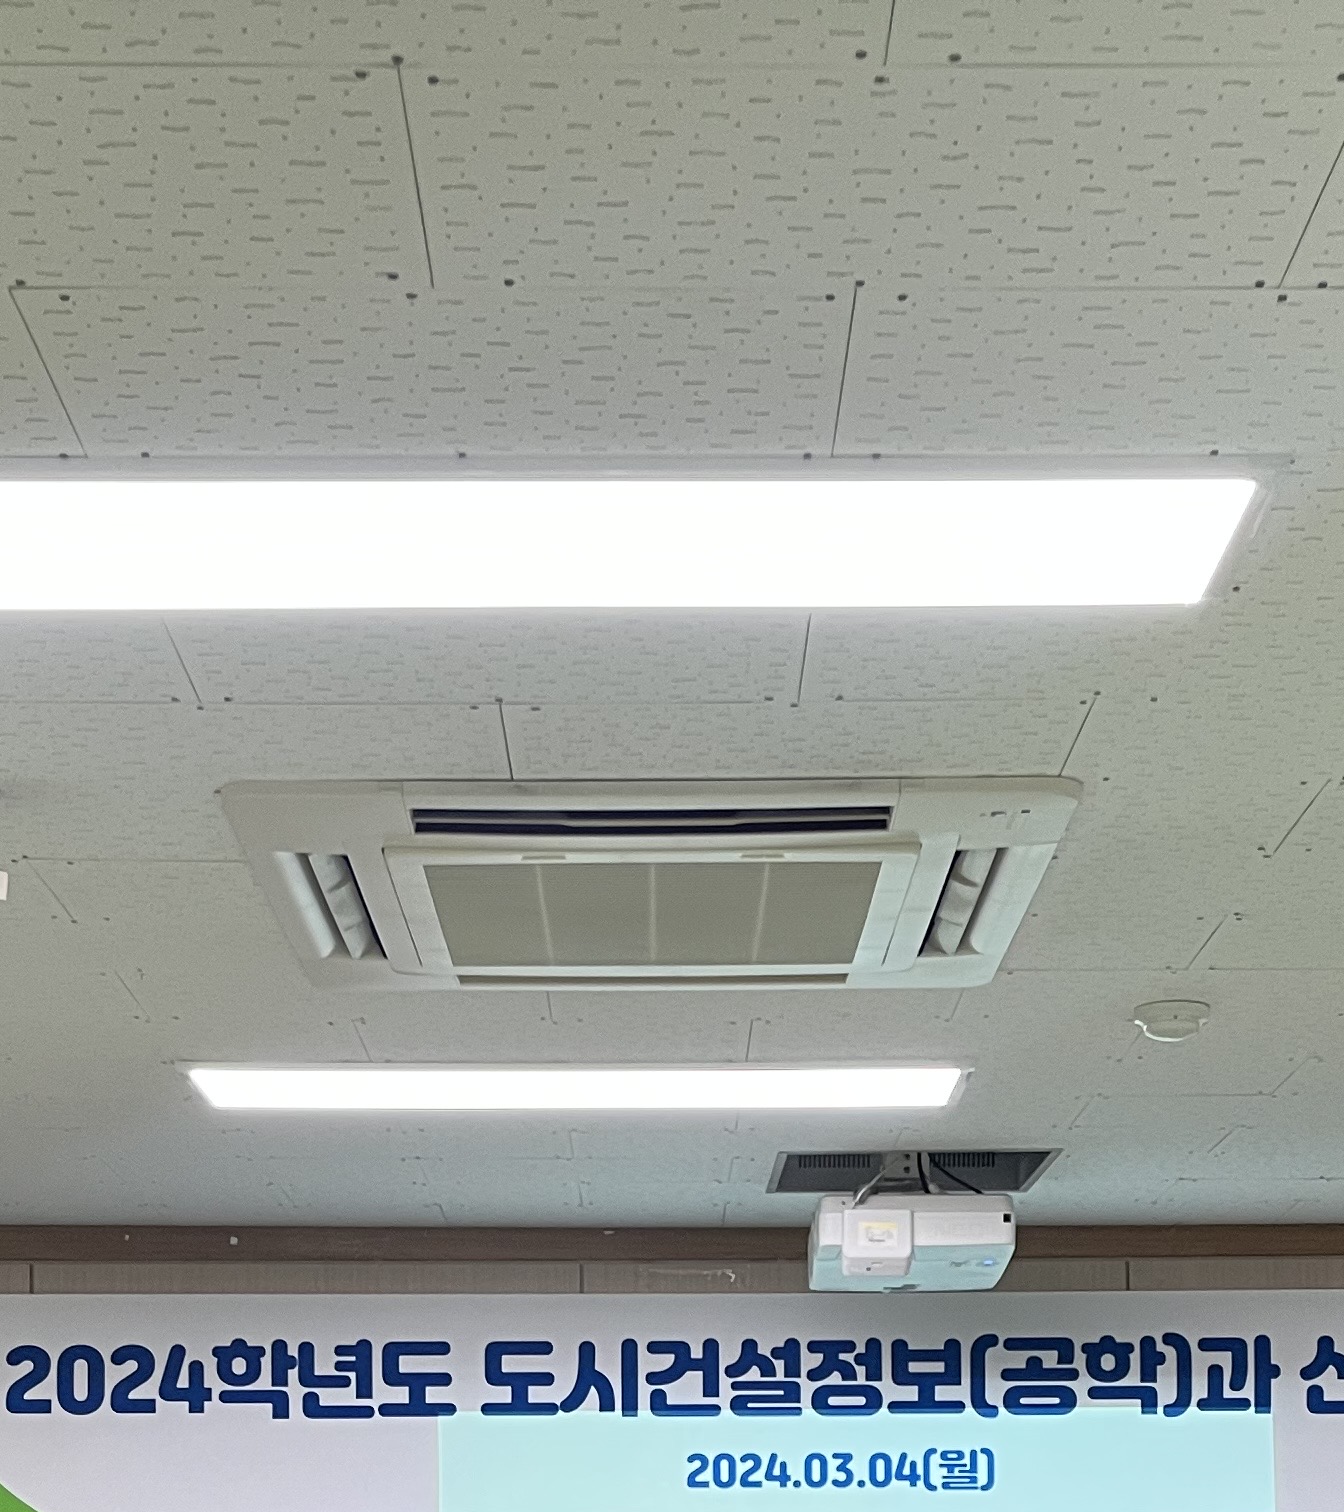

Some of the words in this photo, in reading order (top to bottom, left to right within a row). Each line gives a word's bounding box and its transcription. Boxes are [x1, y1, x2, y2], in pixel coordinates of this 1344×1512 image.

[5, 1338, 457, 1419] 2024학년도
[482, 1334, 1280, 1418] 도시건설정보(공학)과
[686, 1448, 996, 1491] 2024.03.04(월)
